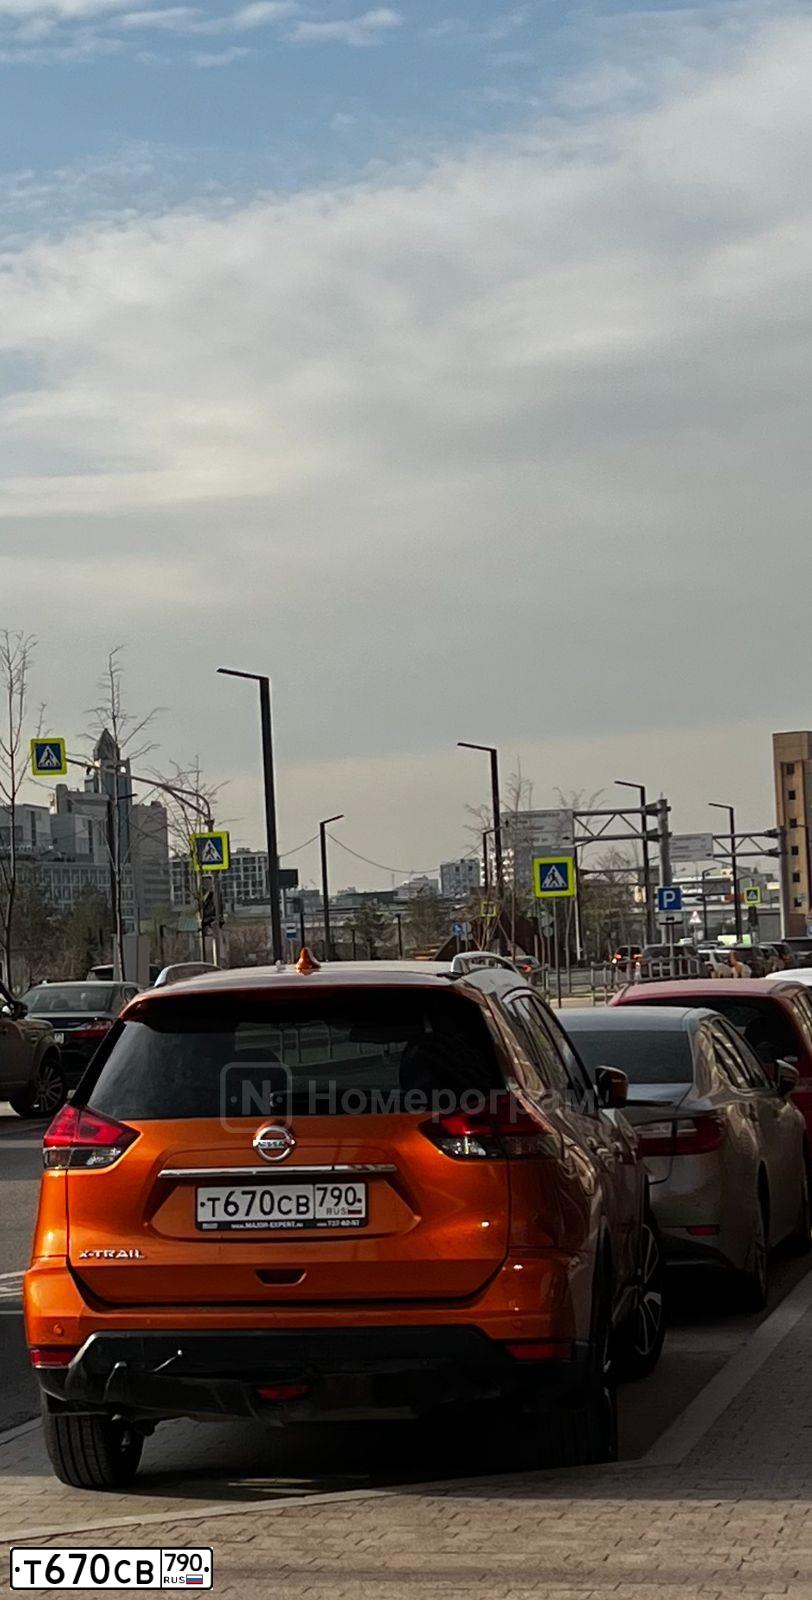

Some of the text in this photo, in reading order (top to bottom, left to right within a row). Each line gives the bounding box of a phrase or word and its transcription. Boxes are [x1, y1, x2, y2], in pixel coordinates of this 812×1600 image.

[206, 1186, 357, 1218] Т670СВ 790
[326, 1207, 346, 1216] RUS
